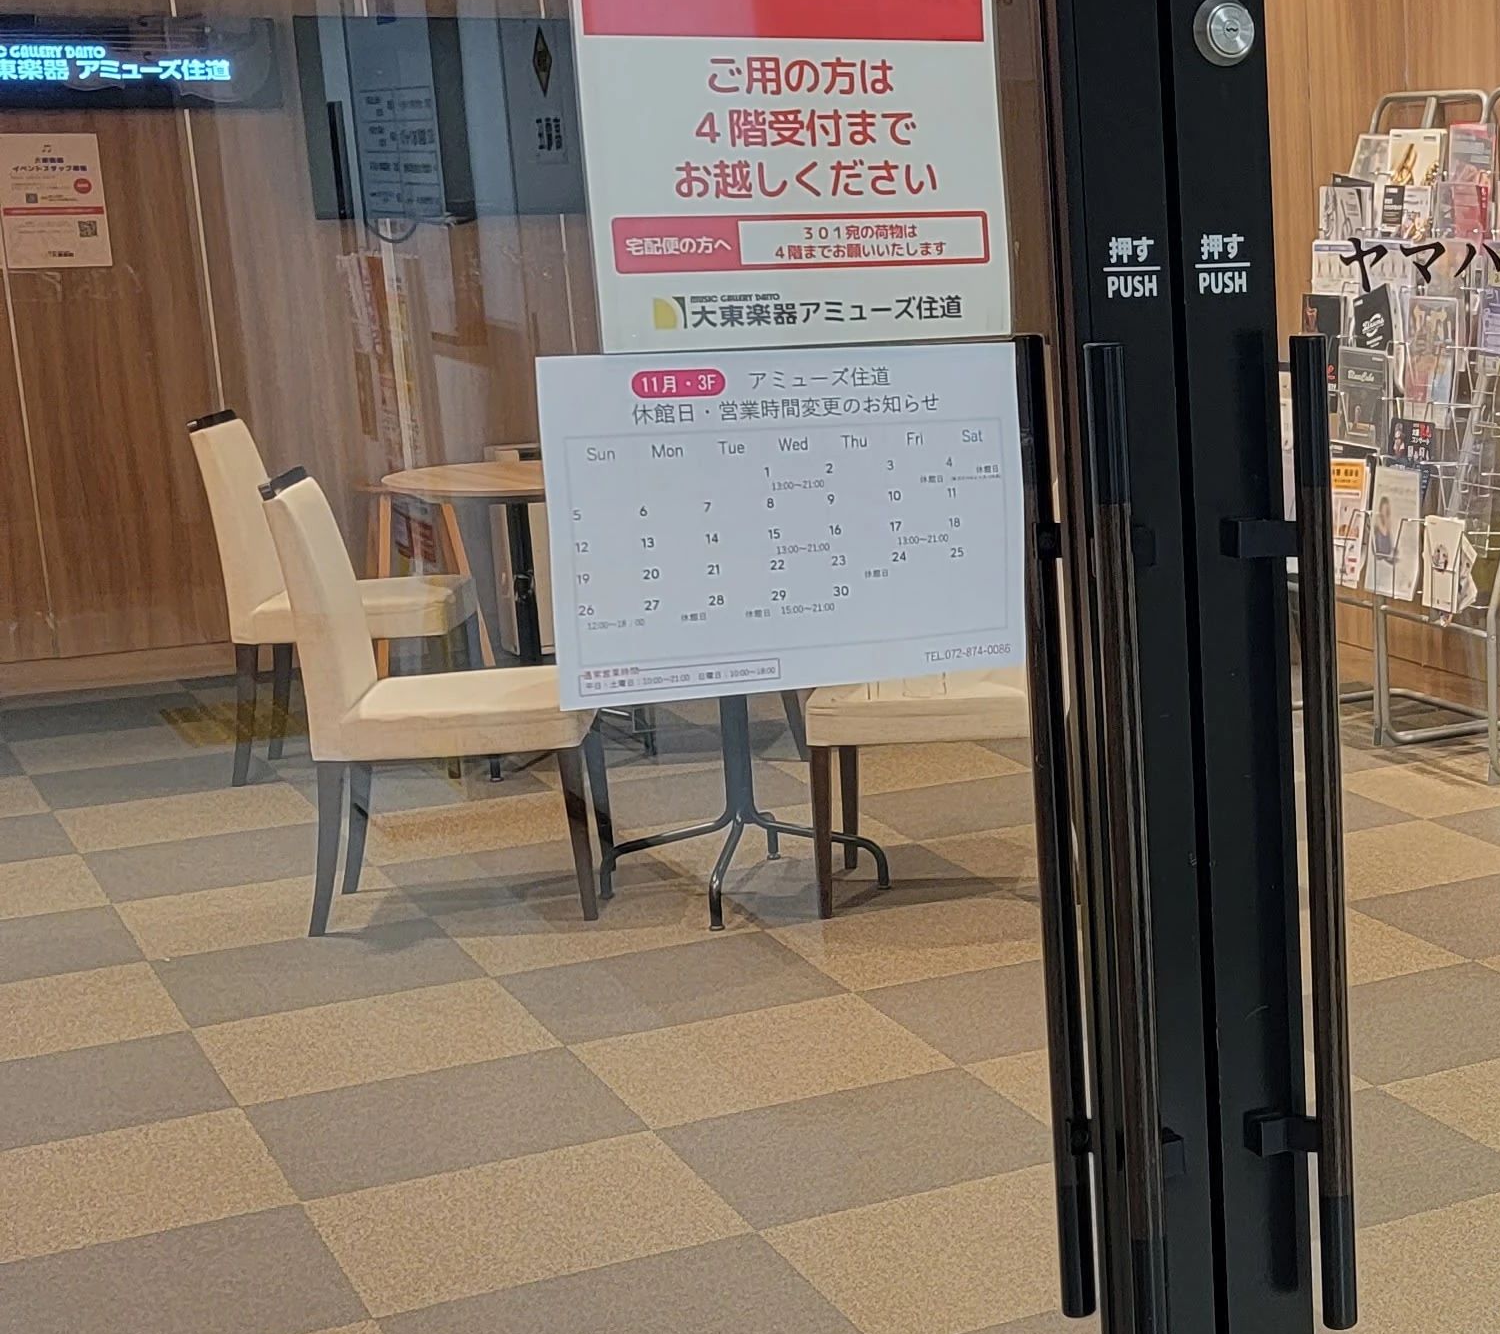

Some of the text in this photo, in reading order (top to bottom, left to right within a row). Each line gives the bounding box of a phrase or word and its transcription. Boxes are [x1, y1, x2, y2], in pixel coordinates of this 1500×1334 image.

[9, 45, 63, 59] GALLERY
[64, 45, 106, 59] DAITO
[76, 59, 231, 80] アミューズ住道
[707, 55, 895, 96] ご用の方は
[675, 160, 937, 201] お越しください
[625, 237, 732, 255] 宅配便の方へ
[1109, 236, 1154, 263] 押す
[1201, 233, 1244, 260] 押す
[1107, 274, 1158, 298] PUSH
[1199, 271, 1247, 294] PUSH
[690, 295, 718, 303] MUSIC
[641, 367, 891, 394] 11月・3F アミューズ住道
[632, 394, 940, 426] 休館日・営業時間変更のお知らせ
[587, 429, 983, 461] Sun Mon Tue Wed Thu Fri Sat
[764, 457, 953, 477] 1 2 3 4
[572, 488, 956, 521] 5 6 7 8 9 10 11
[575, 517, 960, 553] 12 13 14 15 16 17 18
[576, 547, 964, 585] 19 20 21 22 23 24 25
[578, 585, 849, 616] 26 27 28 29 30
